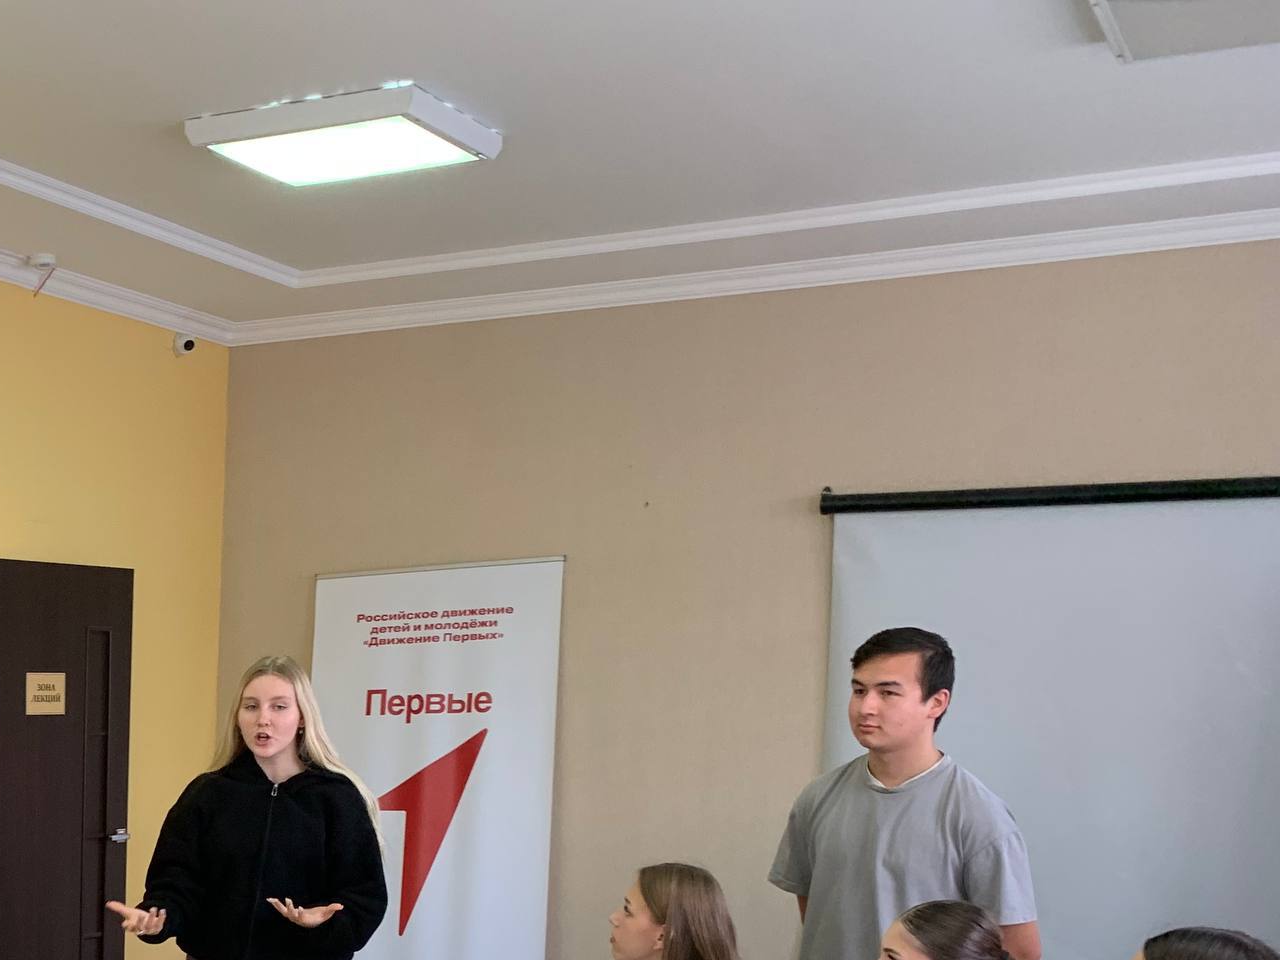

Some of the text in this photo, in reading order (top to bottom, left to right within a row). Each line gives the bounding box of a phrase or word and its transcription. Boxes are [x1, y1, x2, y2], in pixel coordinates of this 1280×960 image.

[356, 605, 514, 623] Российское движение
[370, 618, 498, 635] детей и молодёжи
[363, 631, 504, 647] «Движение Первых»
[36, 683, 56, 691] ЗОНА
[31, 692, 61, 703] ЛЕКЦИЙ
[365, 689, 493, 723] Первые
